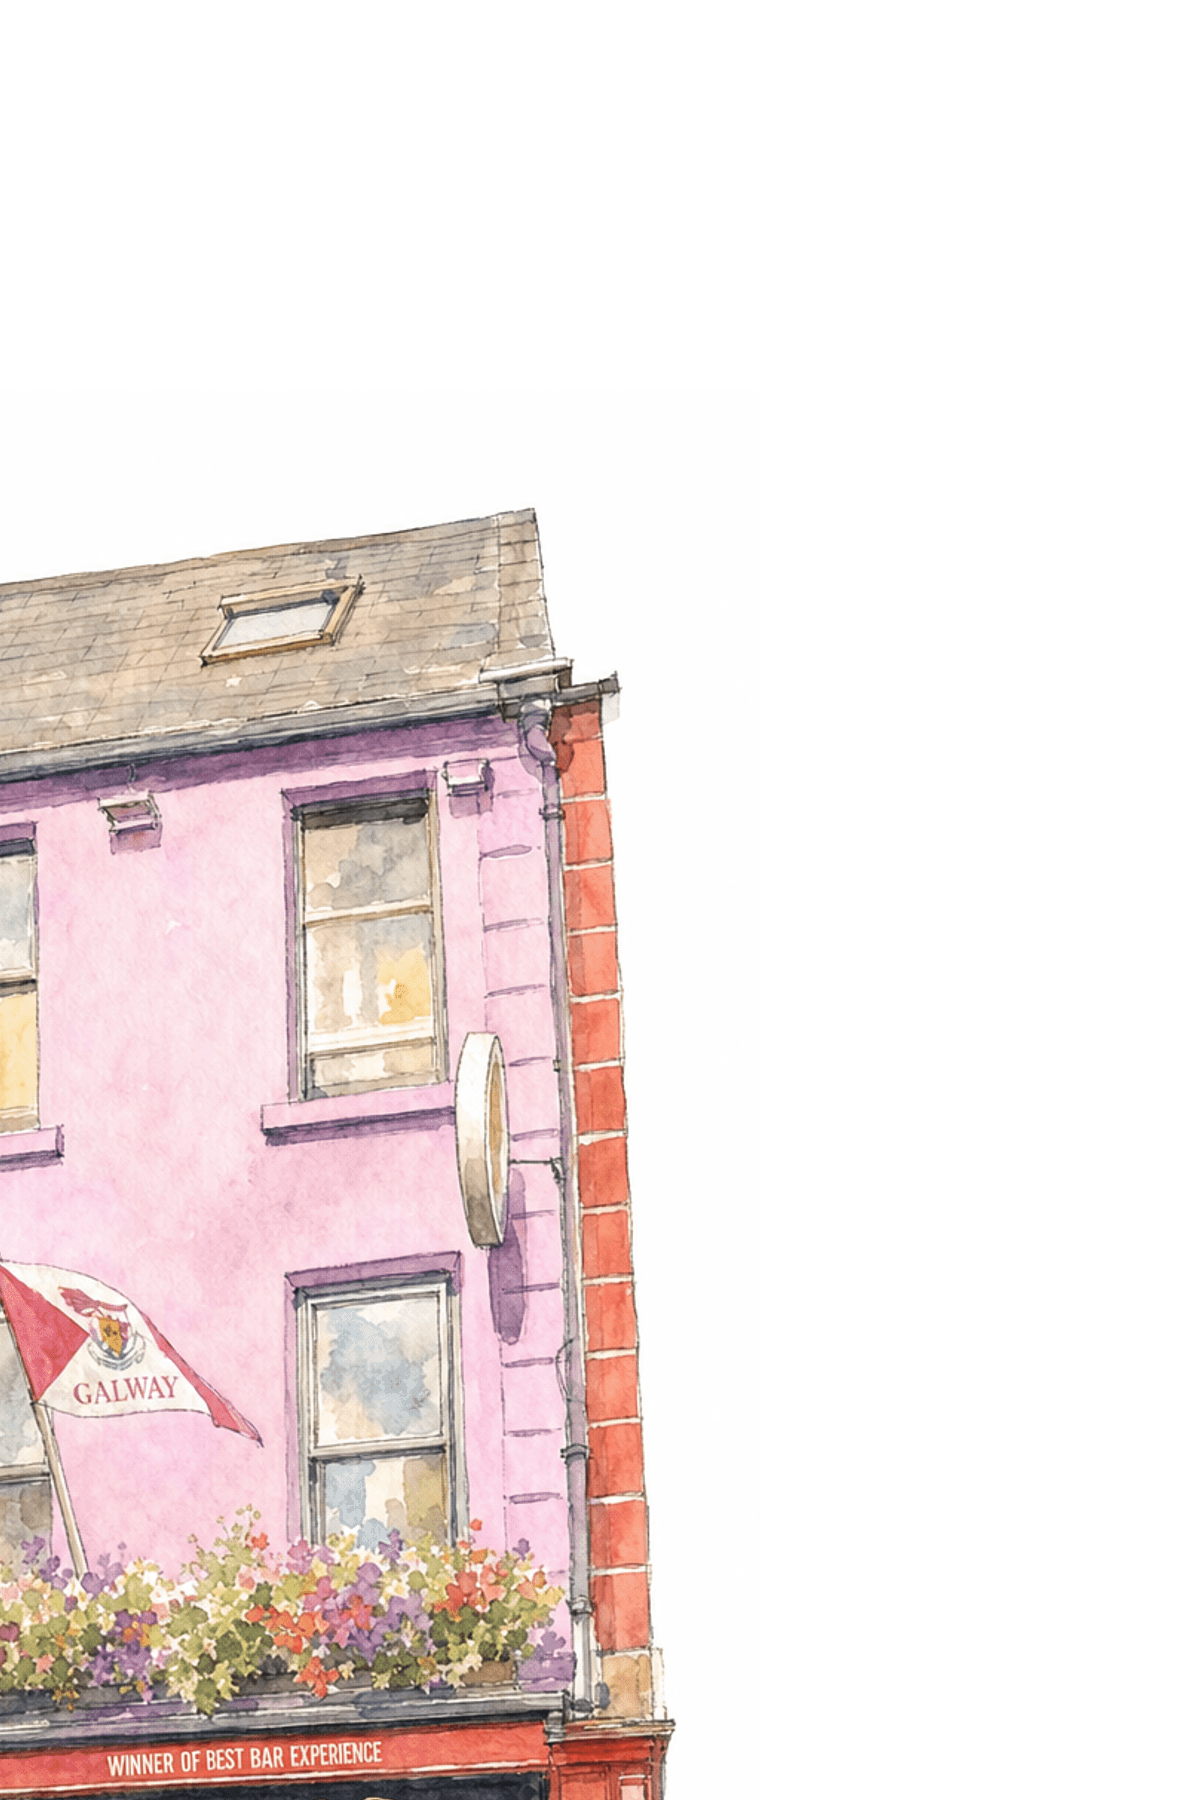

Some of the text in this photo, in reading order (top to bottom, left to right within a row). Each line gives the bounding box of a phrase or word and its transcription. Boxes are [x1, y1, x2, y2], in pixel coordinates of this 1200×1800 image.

[73, 1376, 179, 1404] GALWAY
[107, 1741, 382, 1777] WINNER OF BEST BAR EXPERIENCE
